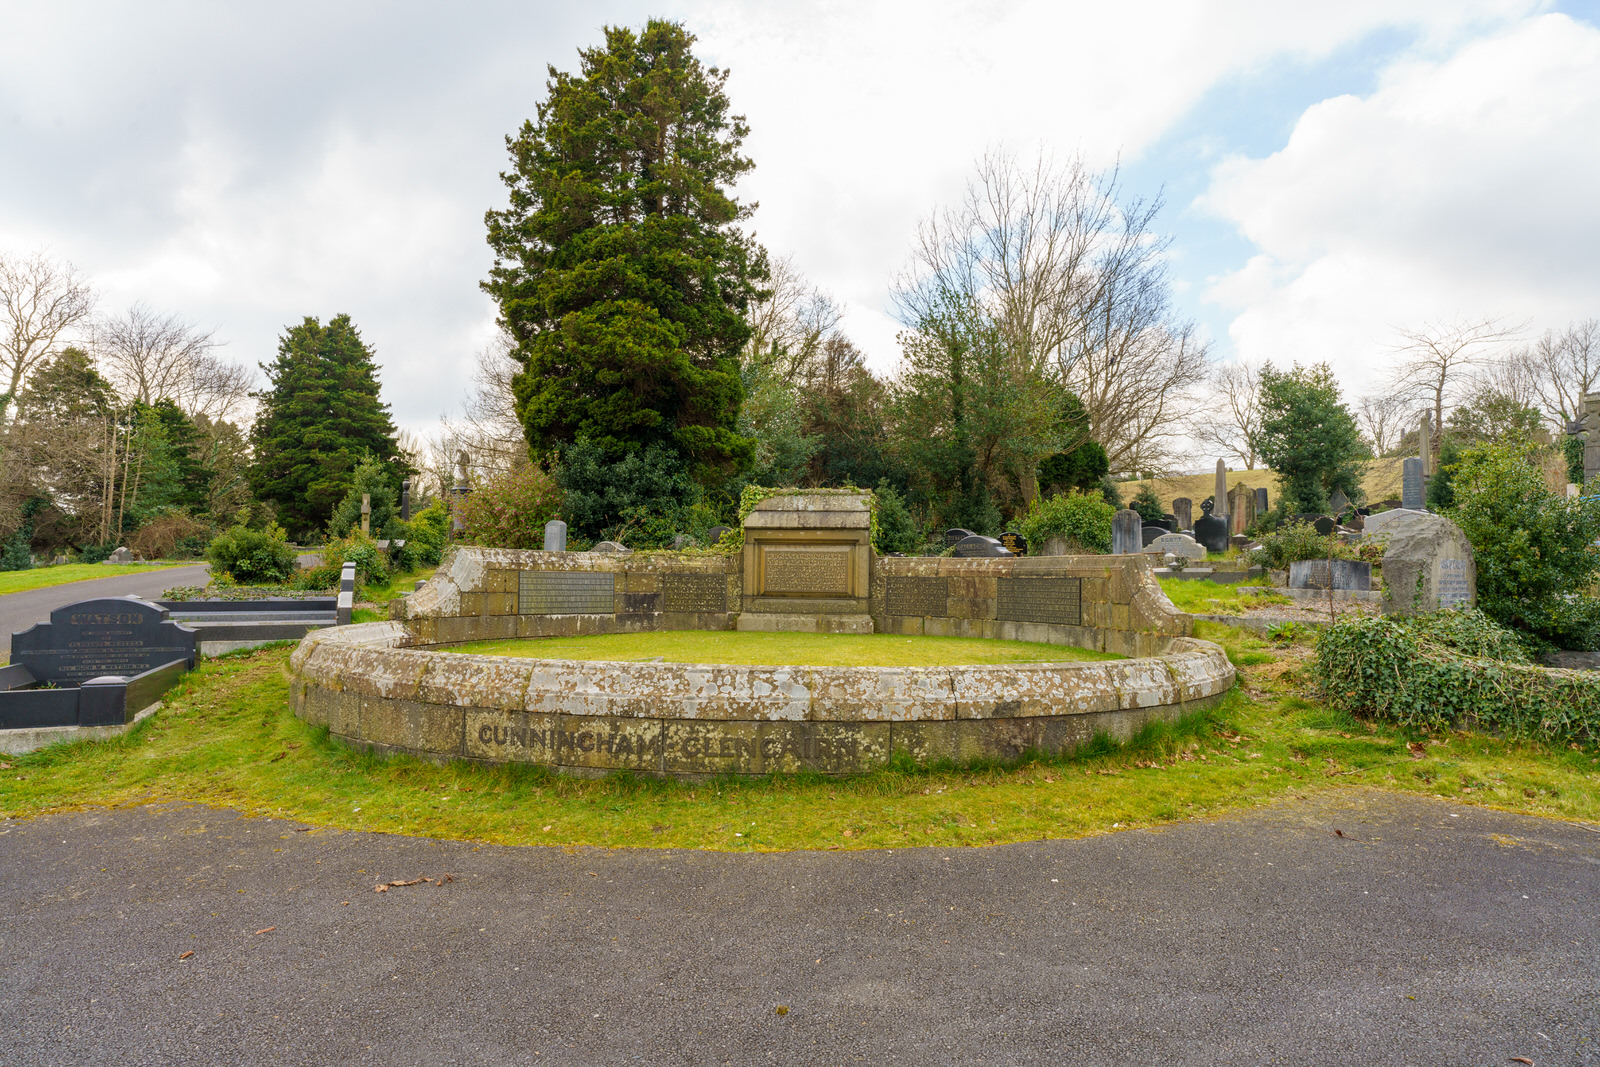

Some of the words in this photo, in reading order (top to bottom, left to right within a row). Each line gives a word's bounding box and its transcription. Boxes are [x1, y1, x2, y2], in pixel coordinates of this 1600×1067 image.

[71, 613, 143, 625] WATSON
[478, 724, 662, 756] CUNNINGHAM
[681, 736, 857, 758] GLENCAIRN
